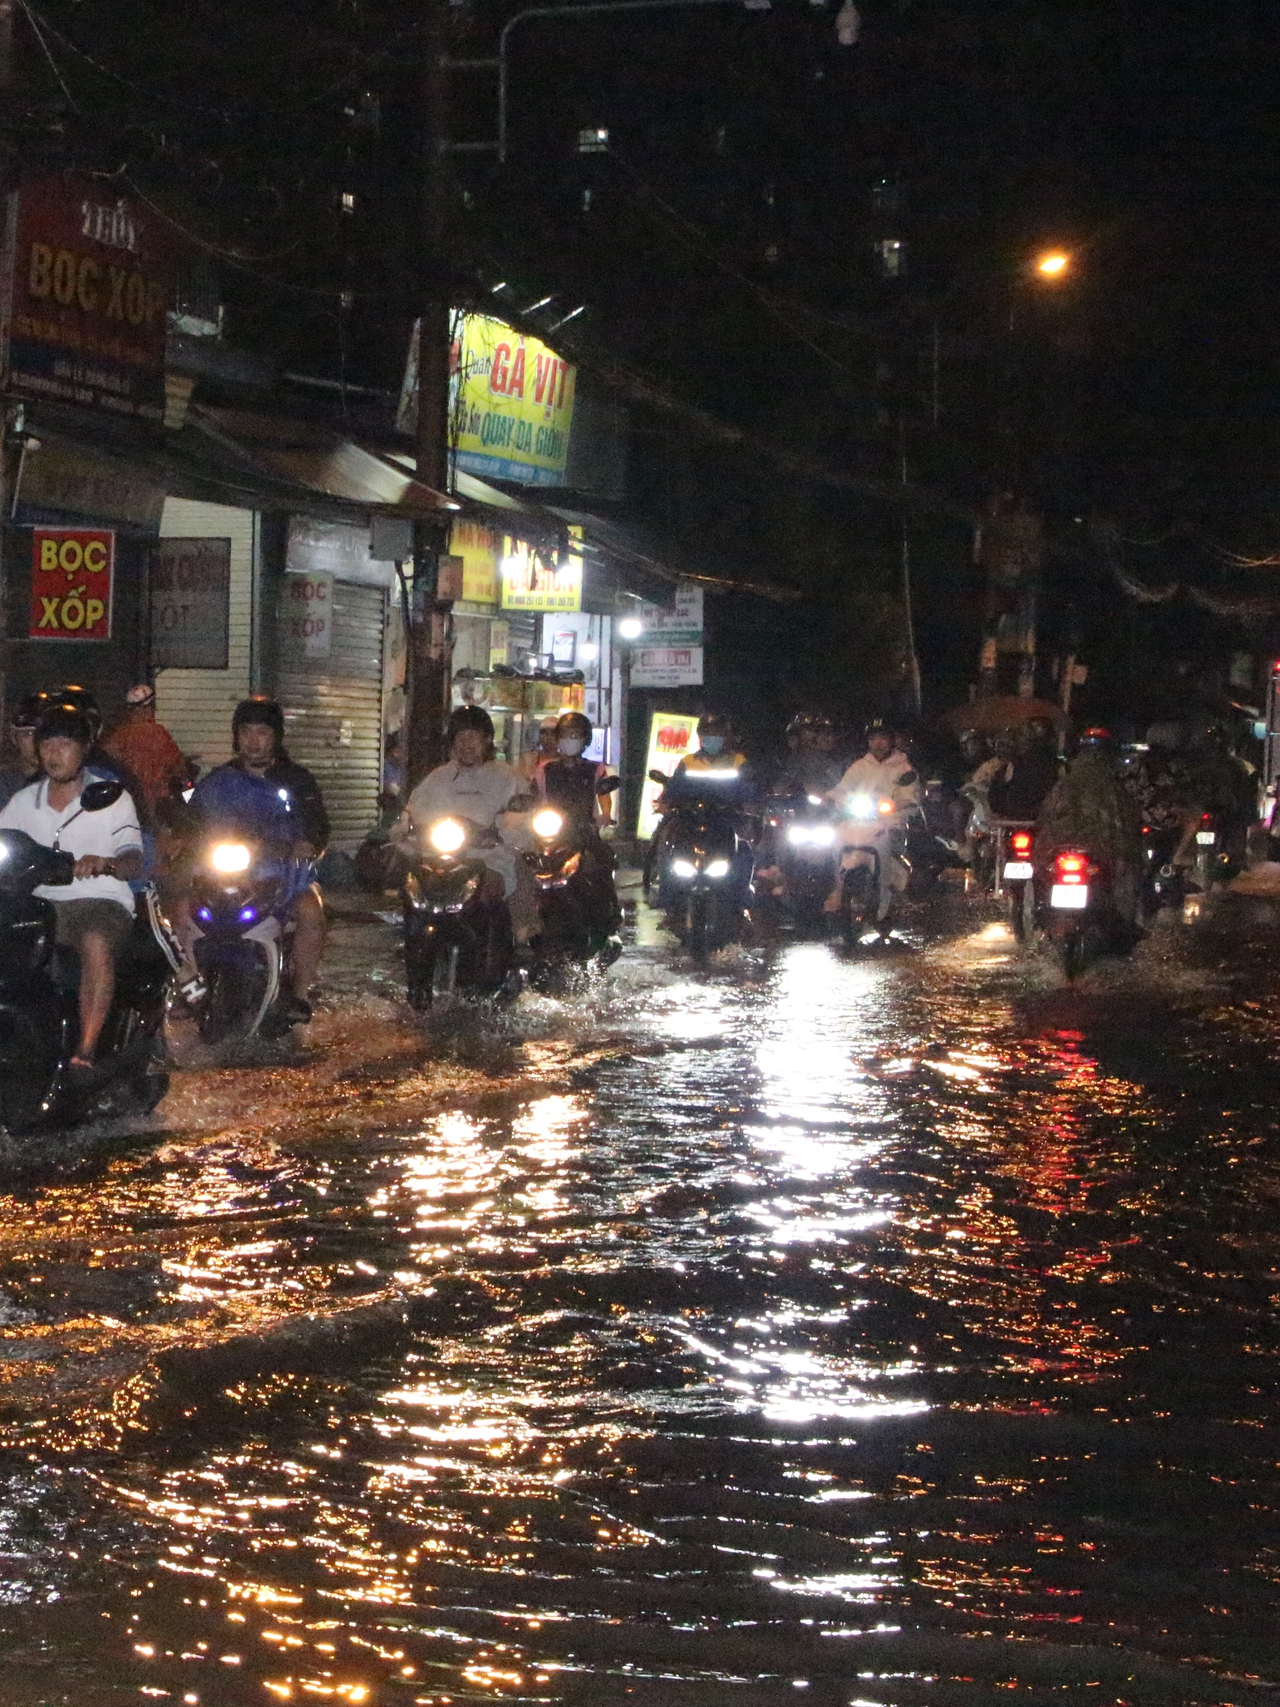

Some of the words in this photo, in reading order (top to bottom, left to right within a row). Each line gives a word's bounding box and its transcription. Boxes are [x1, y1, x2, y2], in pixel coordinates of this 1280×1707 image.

[490, 336, 526, 400] GÀ
[532, 353, 570, 420] VỊT
[39, 539, 108, 581] BỌC
[37, 585, 105, 631] XỐP
